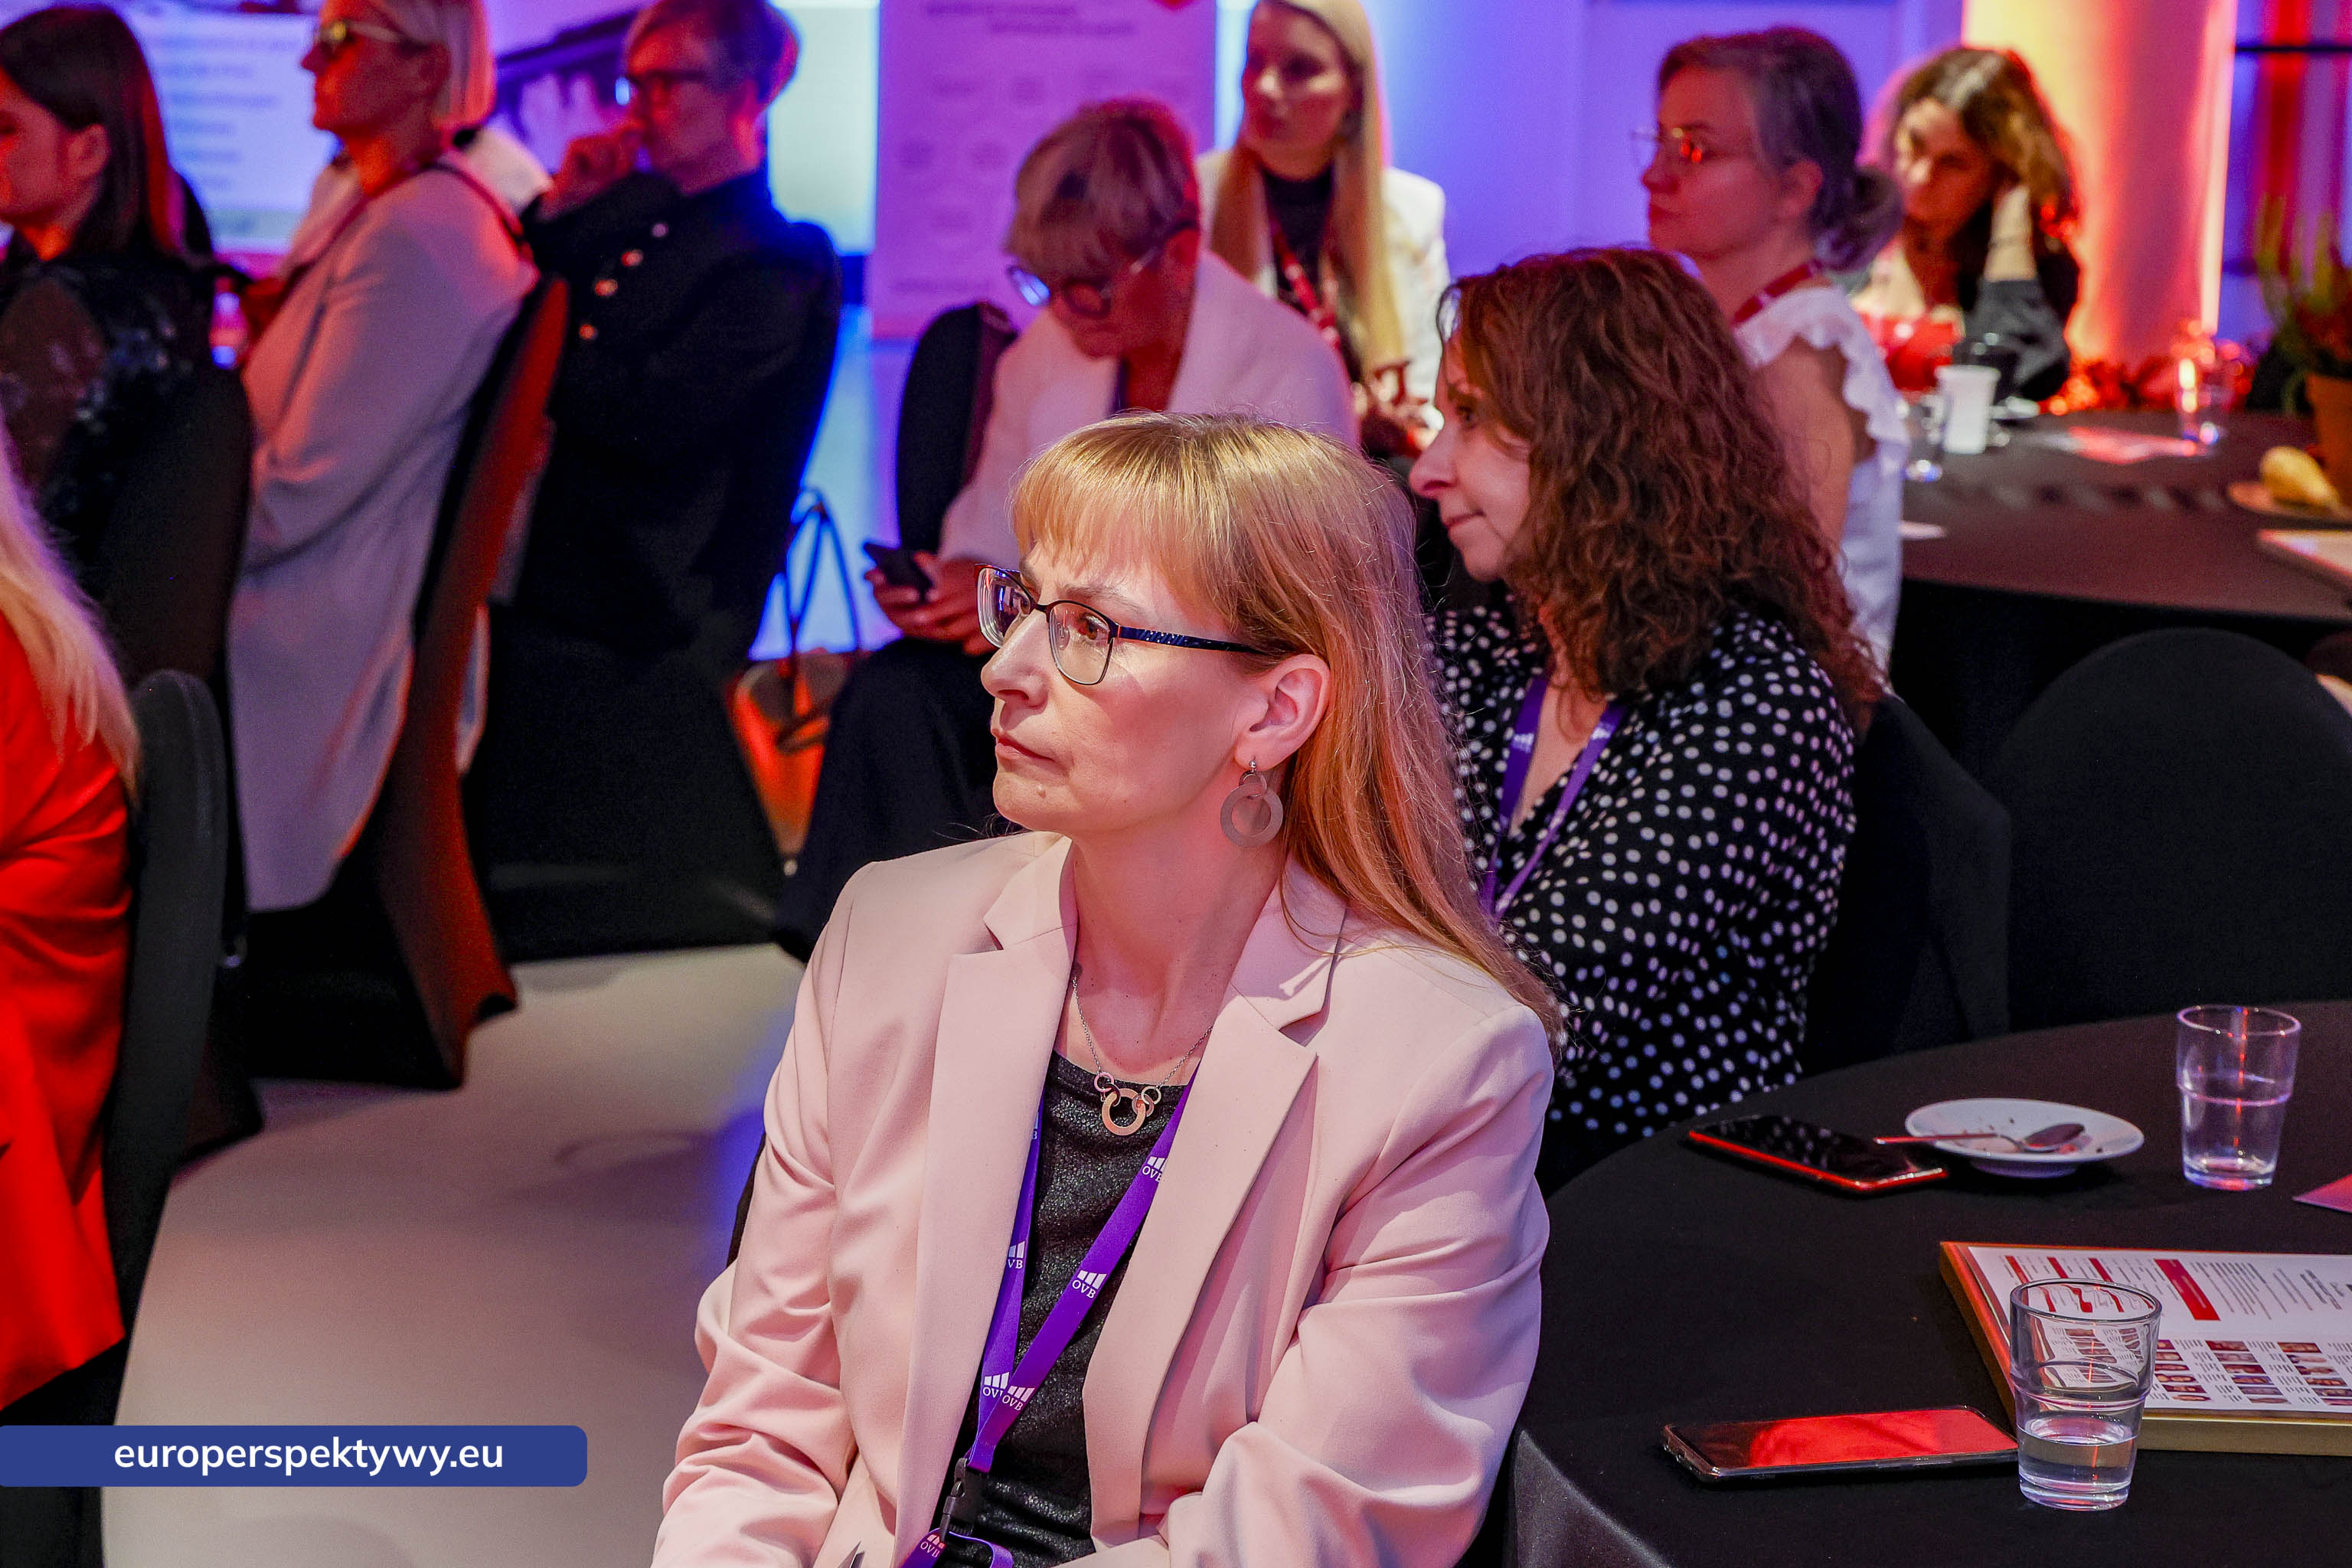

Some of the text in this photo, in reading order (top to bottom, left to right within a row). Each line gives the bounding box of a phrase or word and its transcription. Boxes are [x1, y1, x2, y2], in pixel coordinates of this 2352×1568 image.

[1008, 1259, 1023, 1269] VB
[1072, 1279, 1096, 1298] OVB
[1001, 1394, 1024, 1411] OVB
